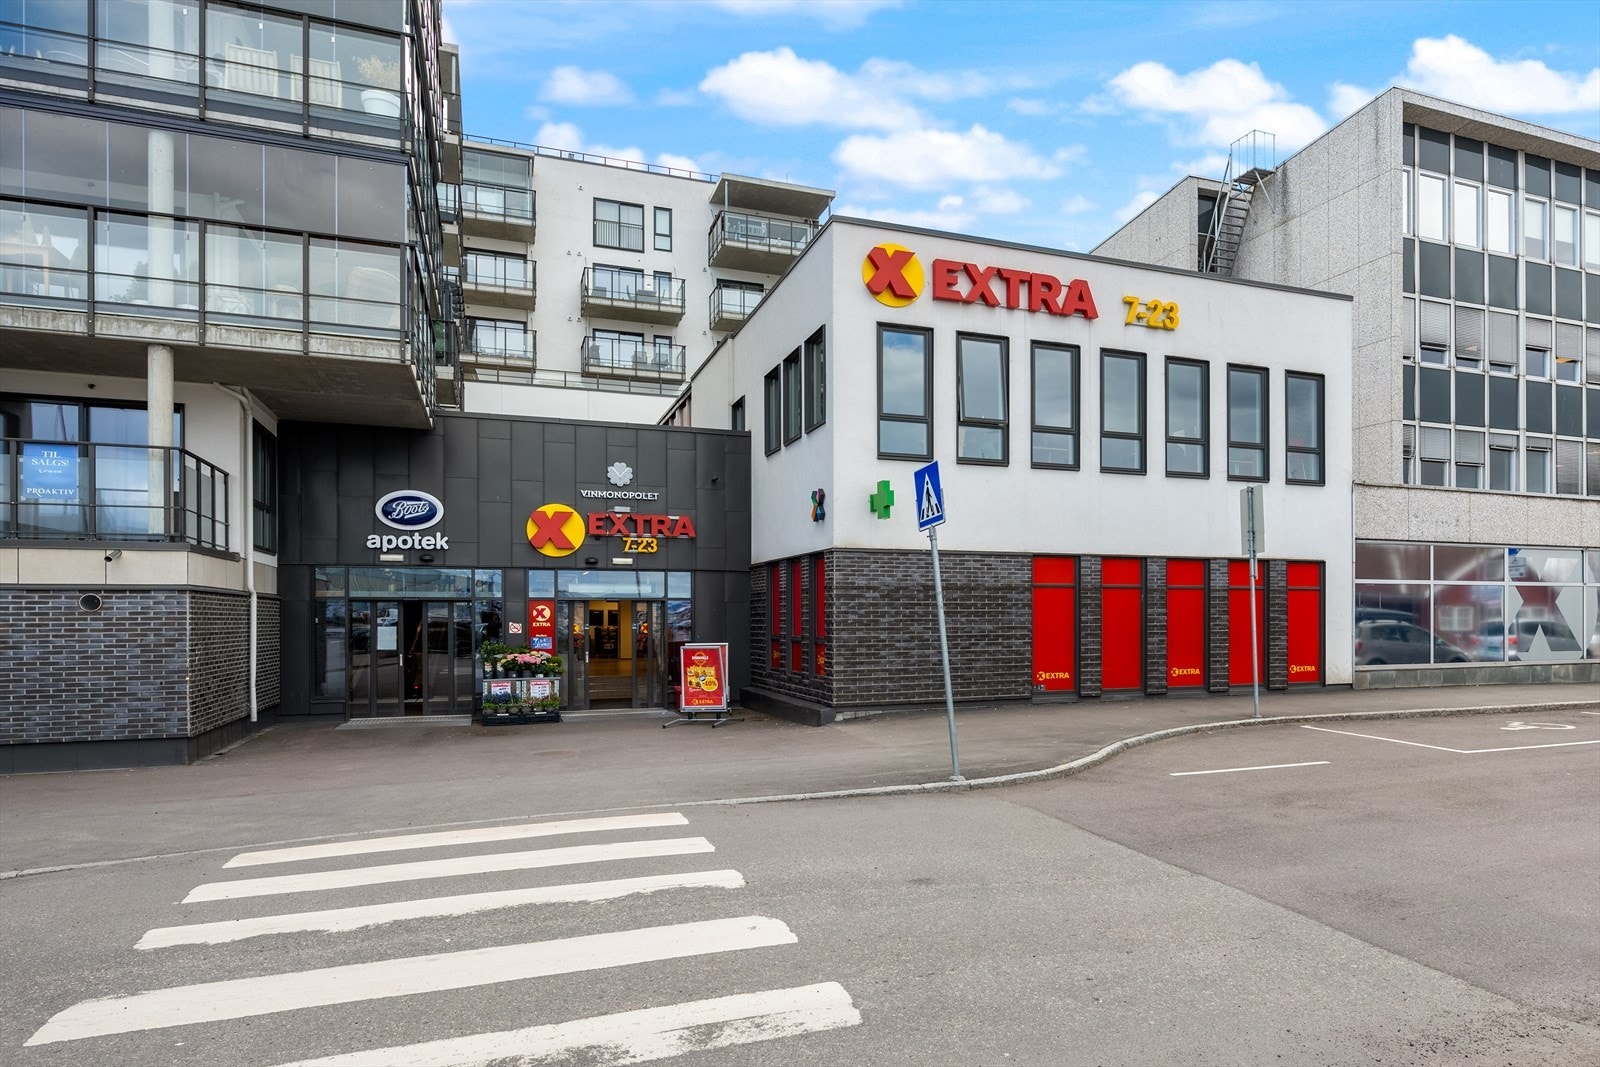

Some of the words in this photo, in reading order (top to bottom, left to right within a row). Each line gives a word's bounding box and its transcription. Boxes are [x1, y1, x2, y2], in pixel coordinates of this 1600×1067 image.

[932, 258, 1099, 320] EXTRA
[1123, 295, 1180, 331] 7-23
[41, 450, 61, 458] TIL
[31, 458, 69, 467] SALGS!
[26, 487, 75, 498] PROAKTIV
[580, 489, 660, 501] VINMONOPOLET
[387, 500, 430, 519] Boots
[587, 512, 697, 539] EXTRA
[366, 532, 449, 552] apotek
[622, 537, 659, 553] 7-23
